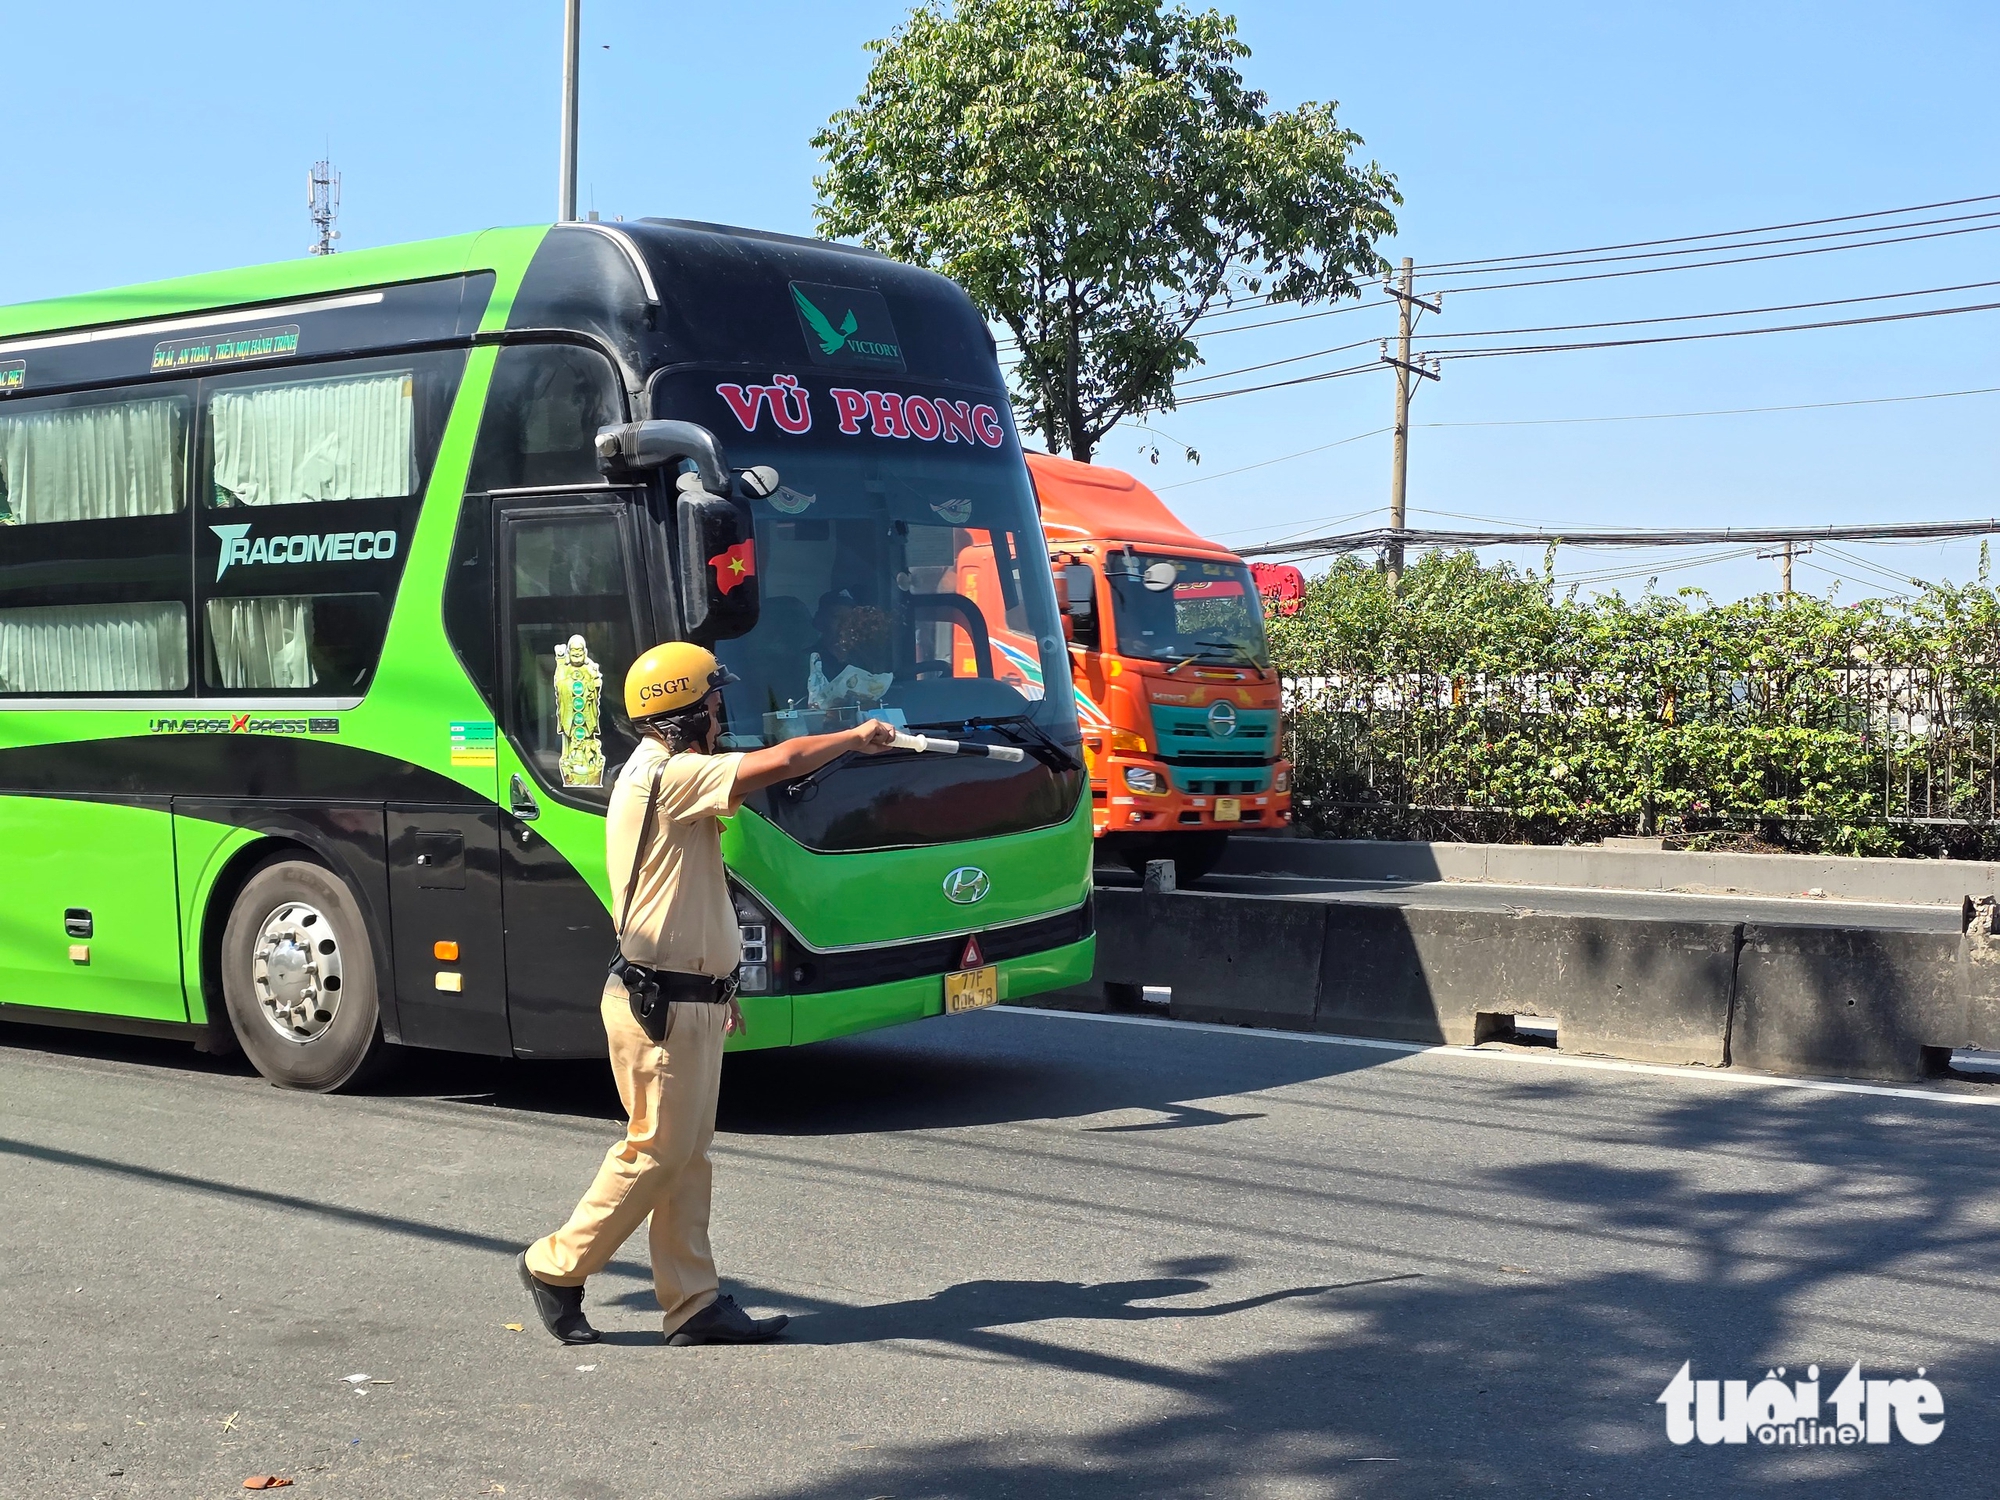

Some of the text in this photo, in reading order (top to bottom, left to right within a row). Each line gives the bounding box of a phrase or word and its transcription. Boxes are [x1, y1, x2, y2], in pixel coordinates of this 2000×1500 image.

[177, 348, 190, 365] AN
[847, 339, 900, 358] VICTORY
[716, 374, 1004, 449] VŨ PHONG
[208, 522, 397, 584] TRACOMECO
[639, 676, 691, 701] CSGT
[961, 970, 983, 990] 77F
